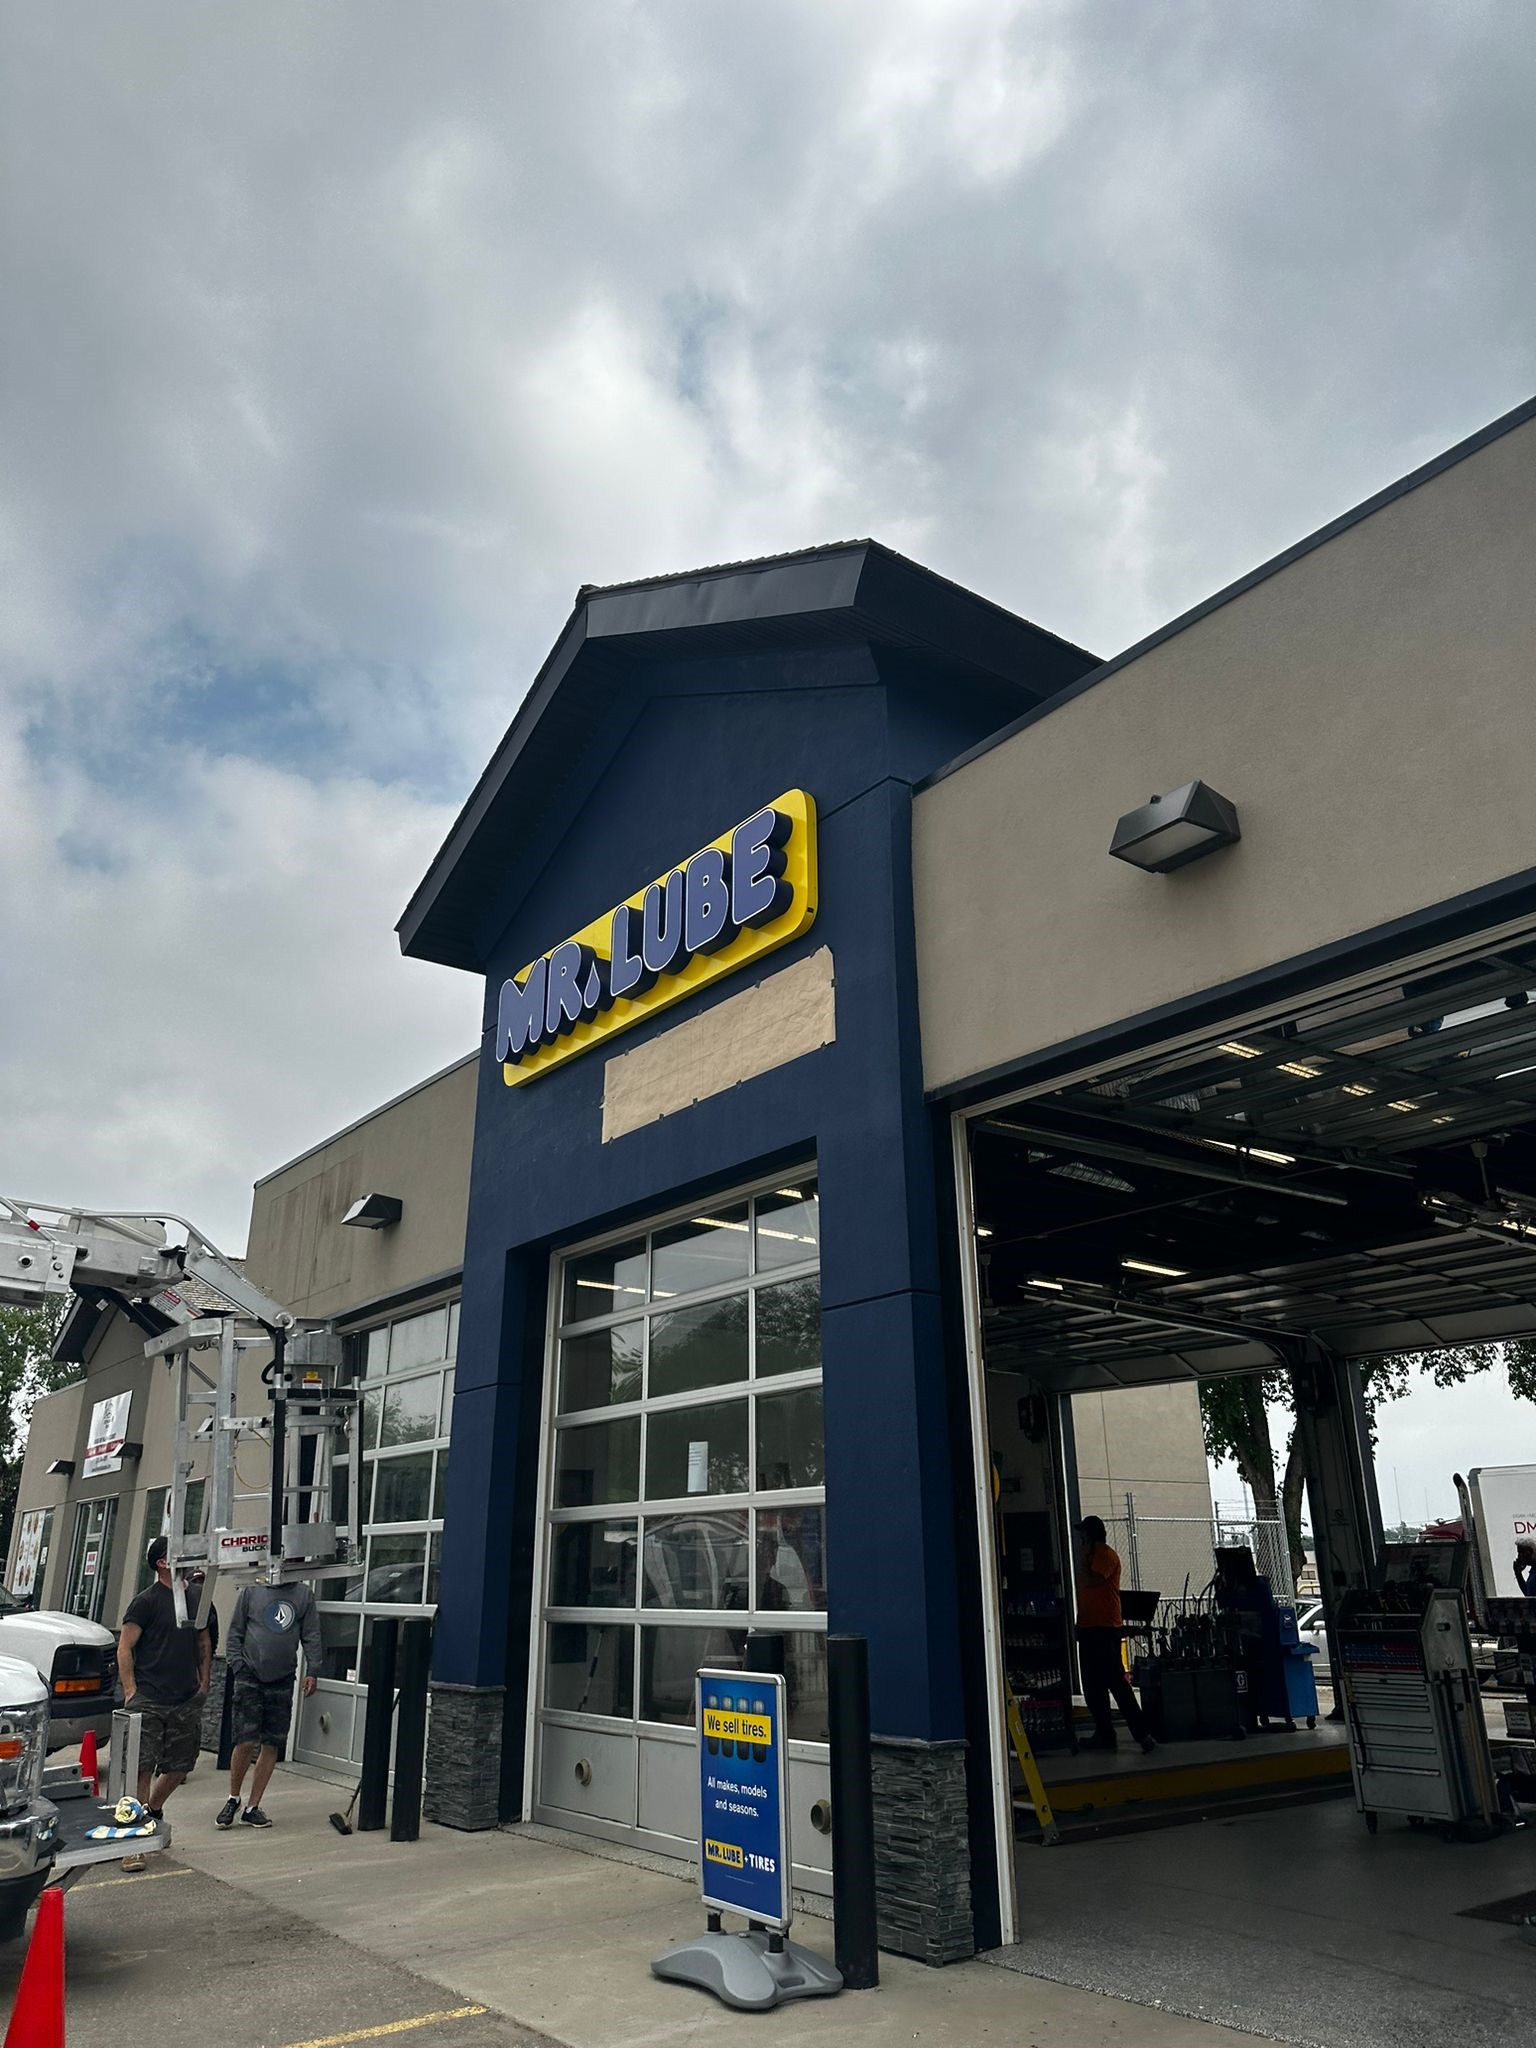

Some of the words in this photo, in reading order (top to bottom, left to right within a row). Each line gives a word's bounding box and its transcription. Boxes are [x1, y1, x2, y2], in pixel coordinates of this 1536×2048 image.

[610, 807, 782, 997] LUBE
[707, 1714, 720, 1731] We
[723, 1718, 739, 1734] sell
[742, 1720, 767, 1738] tires.
[707, 1776, 716, 1788] All
[717, 1779, 740, 1795] makes,
[741, 1784, 768, 1799] models
[715, 1799, 727, 1810] and
[729, 1802, 759, 1817] seasons.
[722, 1847, 741, 1864] LUBE
